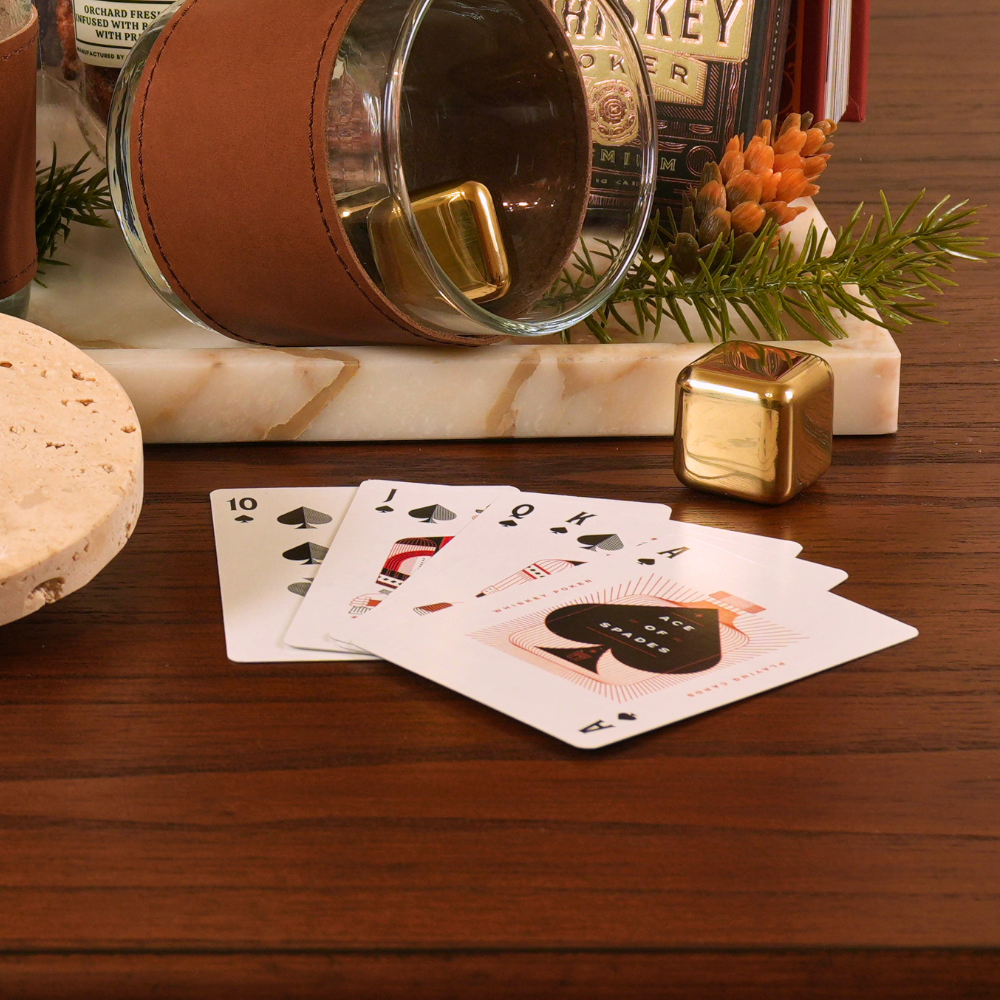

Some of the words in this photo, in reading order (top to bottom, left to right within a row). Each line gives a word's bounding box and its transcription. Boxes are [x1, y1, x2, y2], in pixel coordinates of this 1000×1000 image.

[84, 5, 128, 18] ORCHARD
[75, 13, 109, 28] INFUSED
[111, 20, 139, 30] WITH
[95, 29, 122, 41] WITH
[577, 50, 689, 87] OKER
[383, 488, 398, 503] J
[226, 497, 258, 511] 10
[508, 504, 535, 519] Q
[565, 511, 598, 526] K
[657, 546, 690, 560] A
[493, 593, 548, 614] WHISKEY
[553, 578, 593, 594] POKER
[644, 624, 669, 636] OF
[658, 615, 695, 632] ACE
[599, 621, 670, 654] SPADES
[732, 661, 786, 683] PLAYING
[686, 681, 728, 698] CARDS
[578, 719, 616, 734] A
